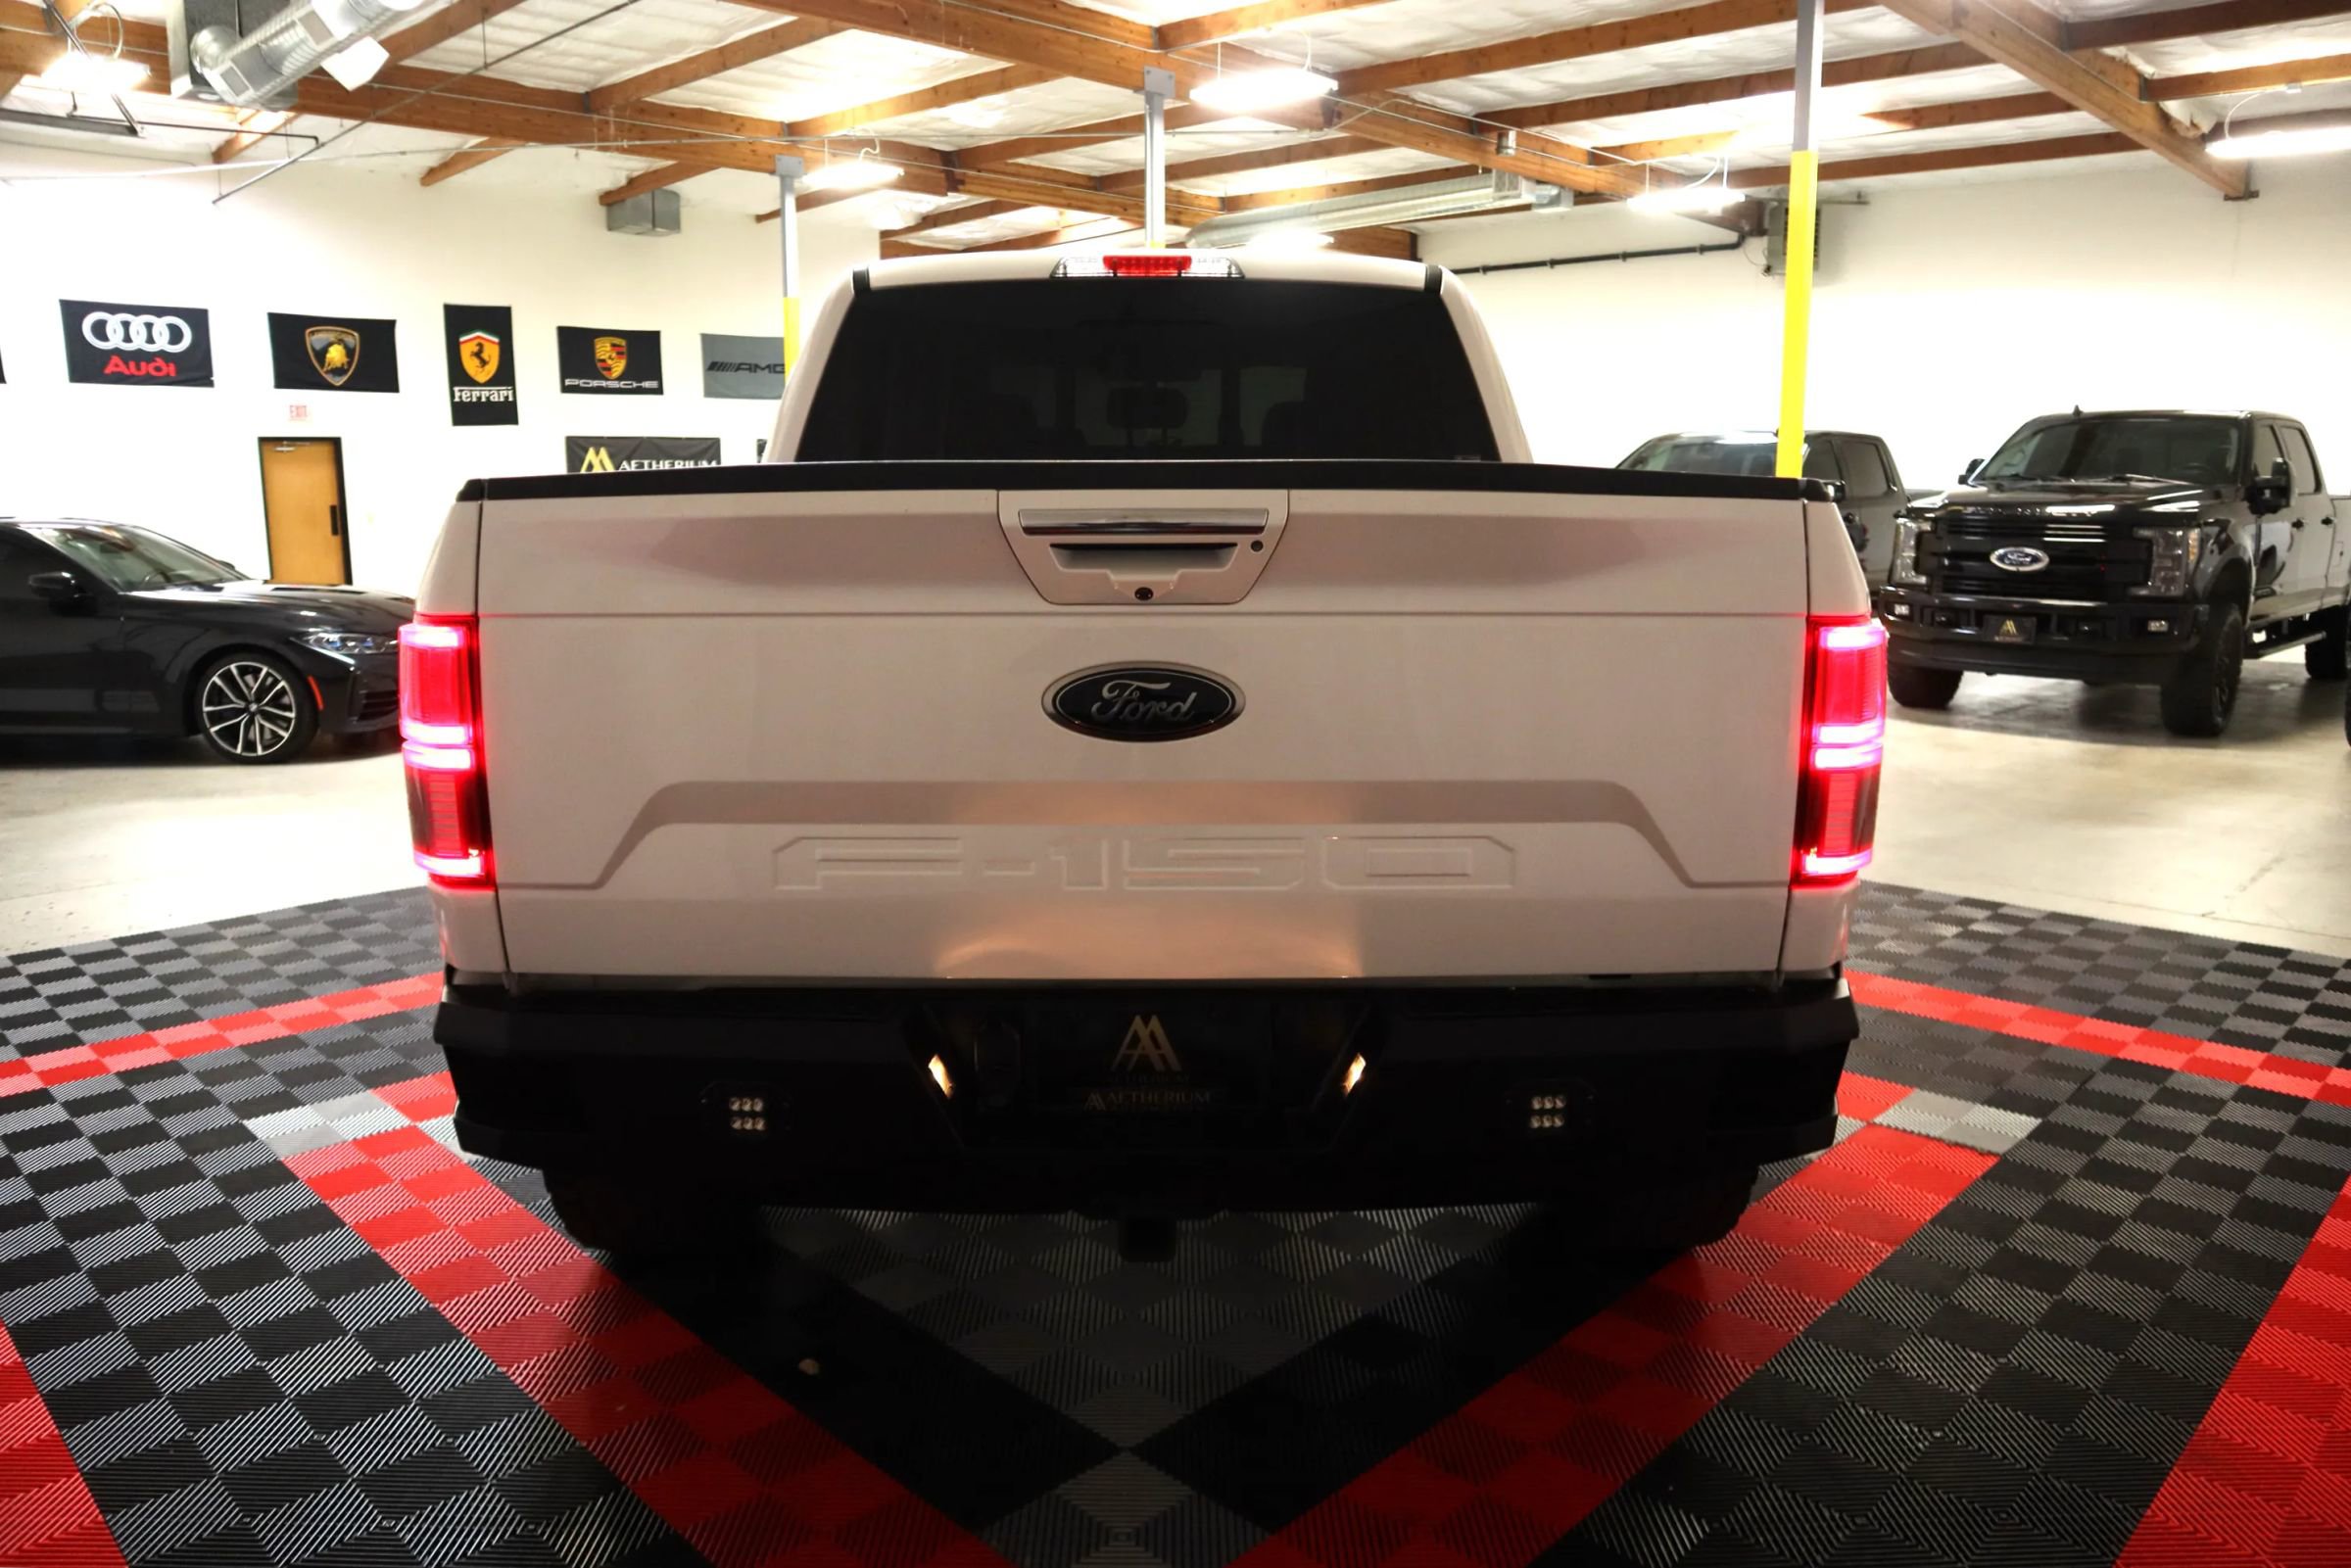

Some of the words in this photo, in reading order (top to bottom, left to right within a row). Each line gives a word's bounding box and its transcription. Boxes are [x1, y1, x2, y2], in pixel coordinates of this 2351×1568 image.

[103, 356, 177, 378] Audi
[735, 361, 787, 374] AMG
[564, 378, 659, 389] PORSCHE
[453, 386, 514, 403] Ferrari
[1090, 679, 1198, 723] Ford
[771, 835, 1516, 891] F-150
